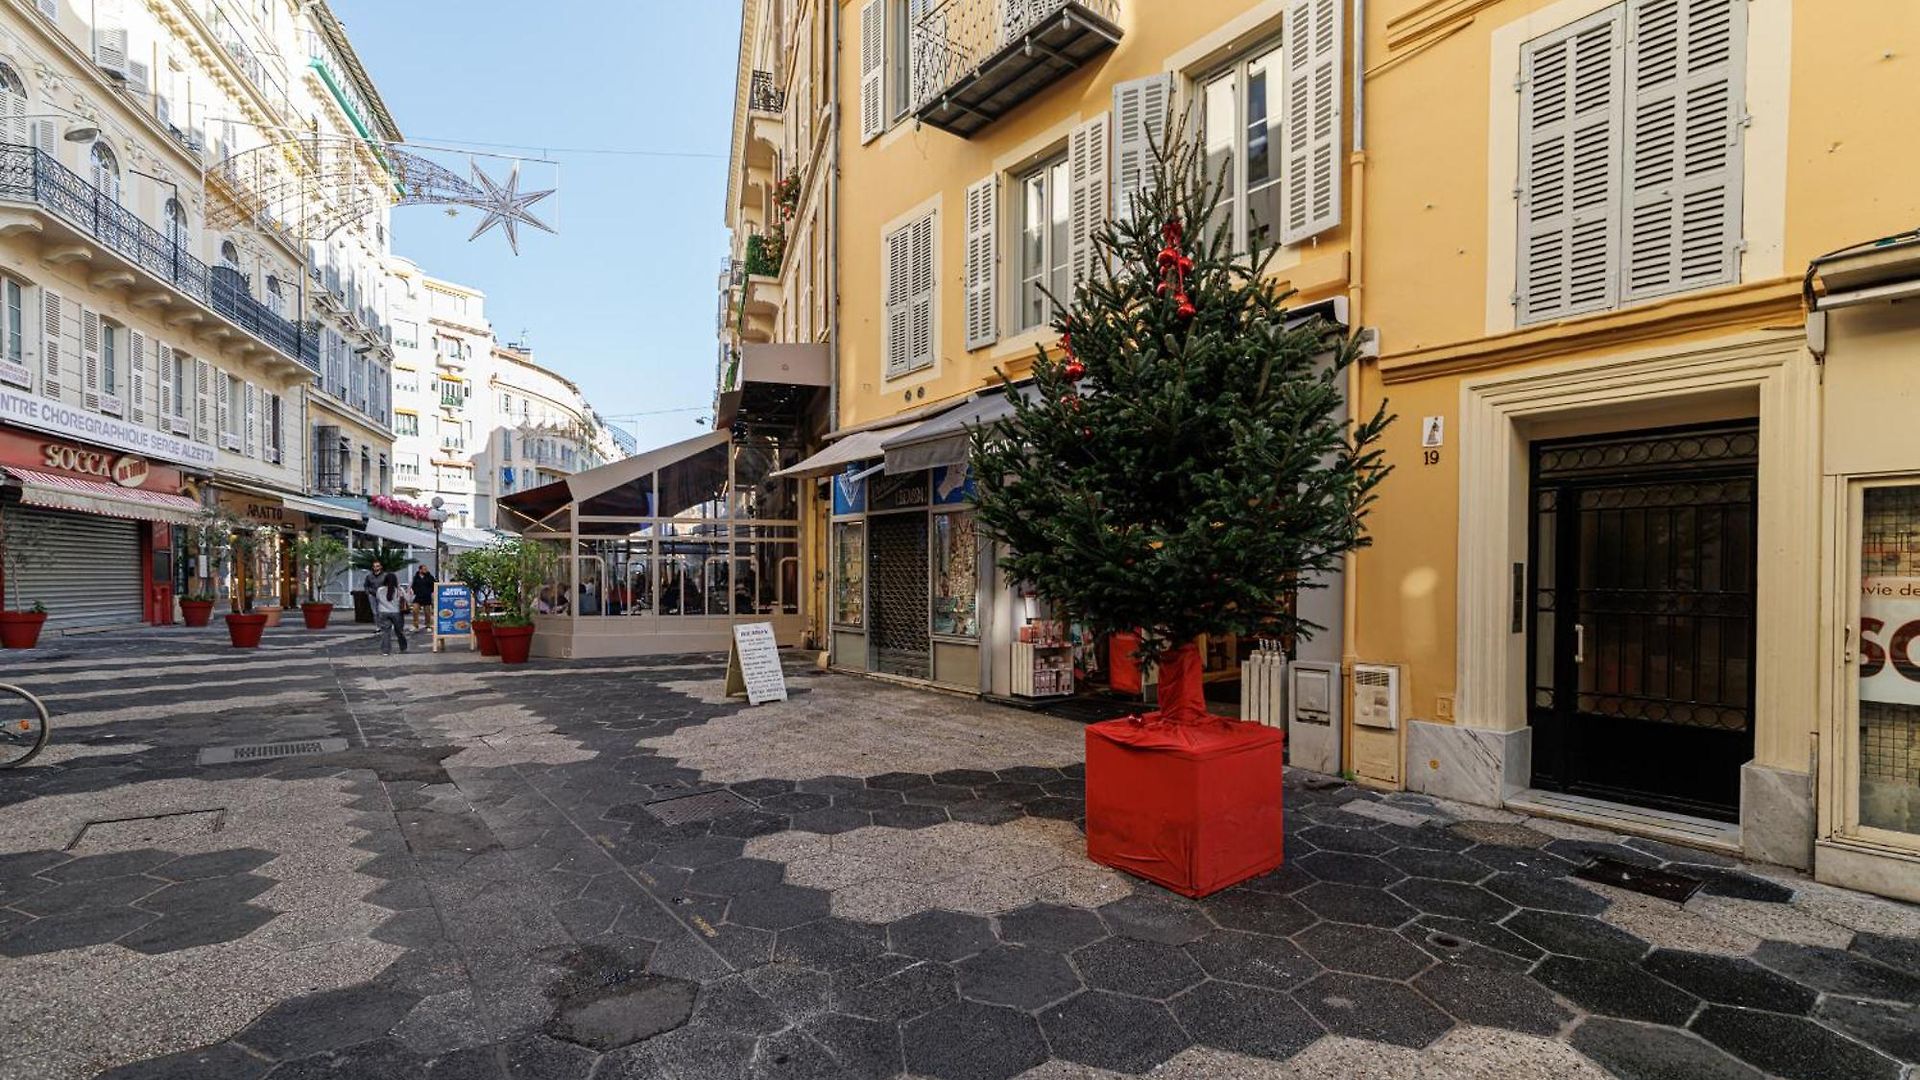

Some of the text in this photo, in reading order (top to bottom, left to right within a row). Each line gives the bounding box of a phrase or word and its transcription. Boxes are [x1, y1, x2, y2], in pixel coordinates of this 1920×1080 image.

[42, 404, 148, 447] CHOREGRAPHIQUE
[151, 435, 180, 455] SERGE
[182, 446, 215, 463] ALZETTA
[45, 444, 112, 477] SOCCA
[1423, 450, 1440, 465] 19
